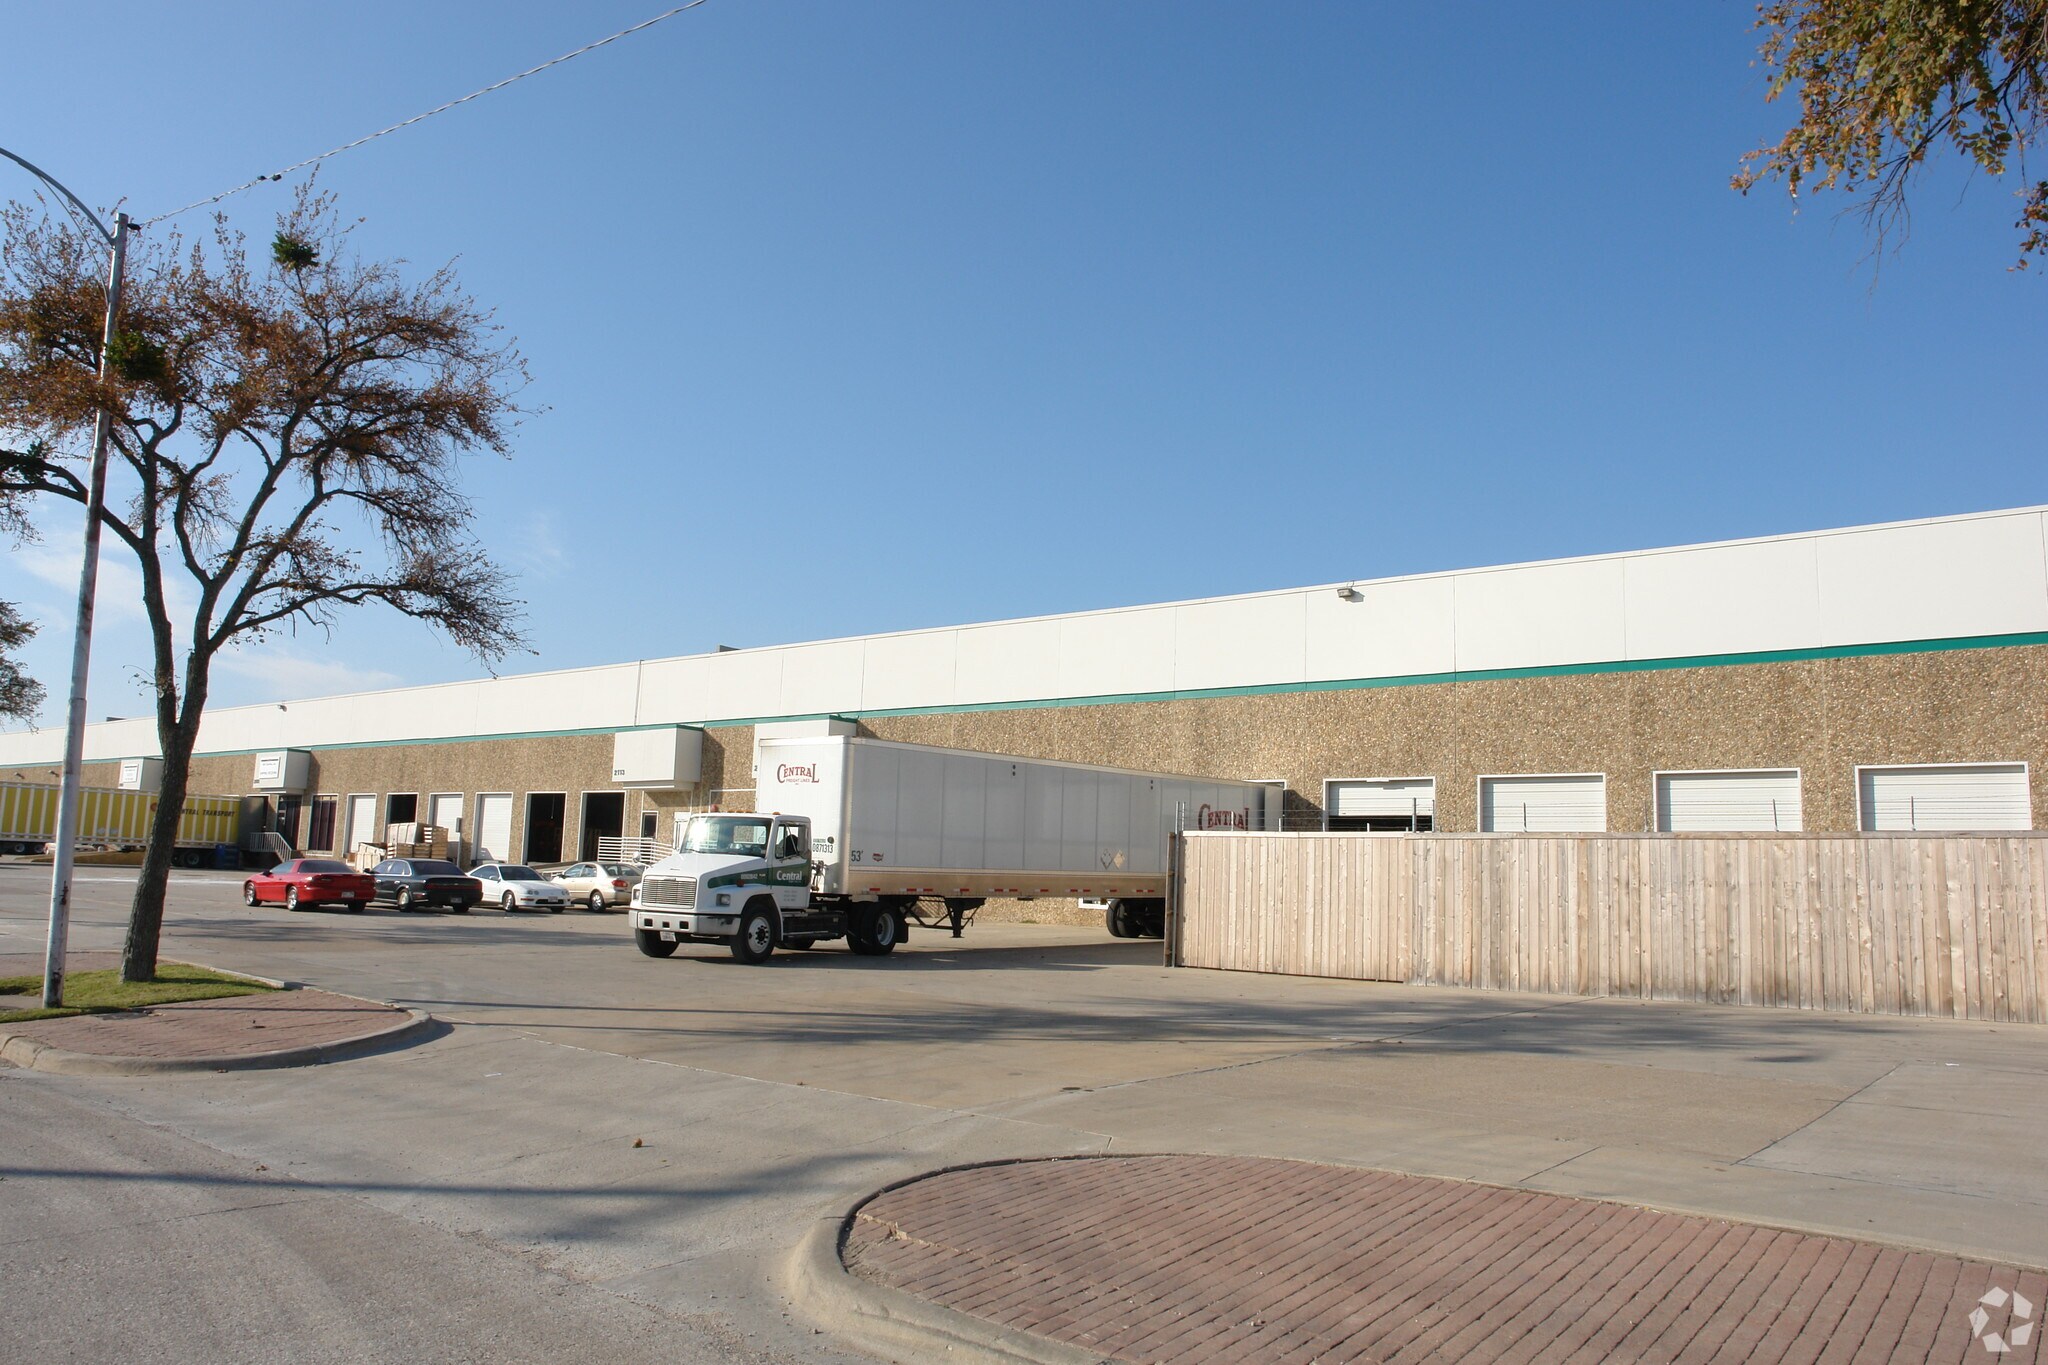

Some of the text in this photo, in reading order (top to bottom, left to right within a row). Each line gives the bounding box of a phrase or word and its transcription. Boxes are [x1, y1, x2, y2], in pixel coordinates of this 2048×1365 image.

[777, 763, 820, 783] CENTRAL
[203, 809, 235, 817] TRANSPORT
[776, 870, 803, 881] Central
